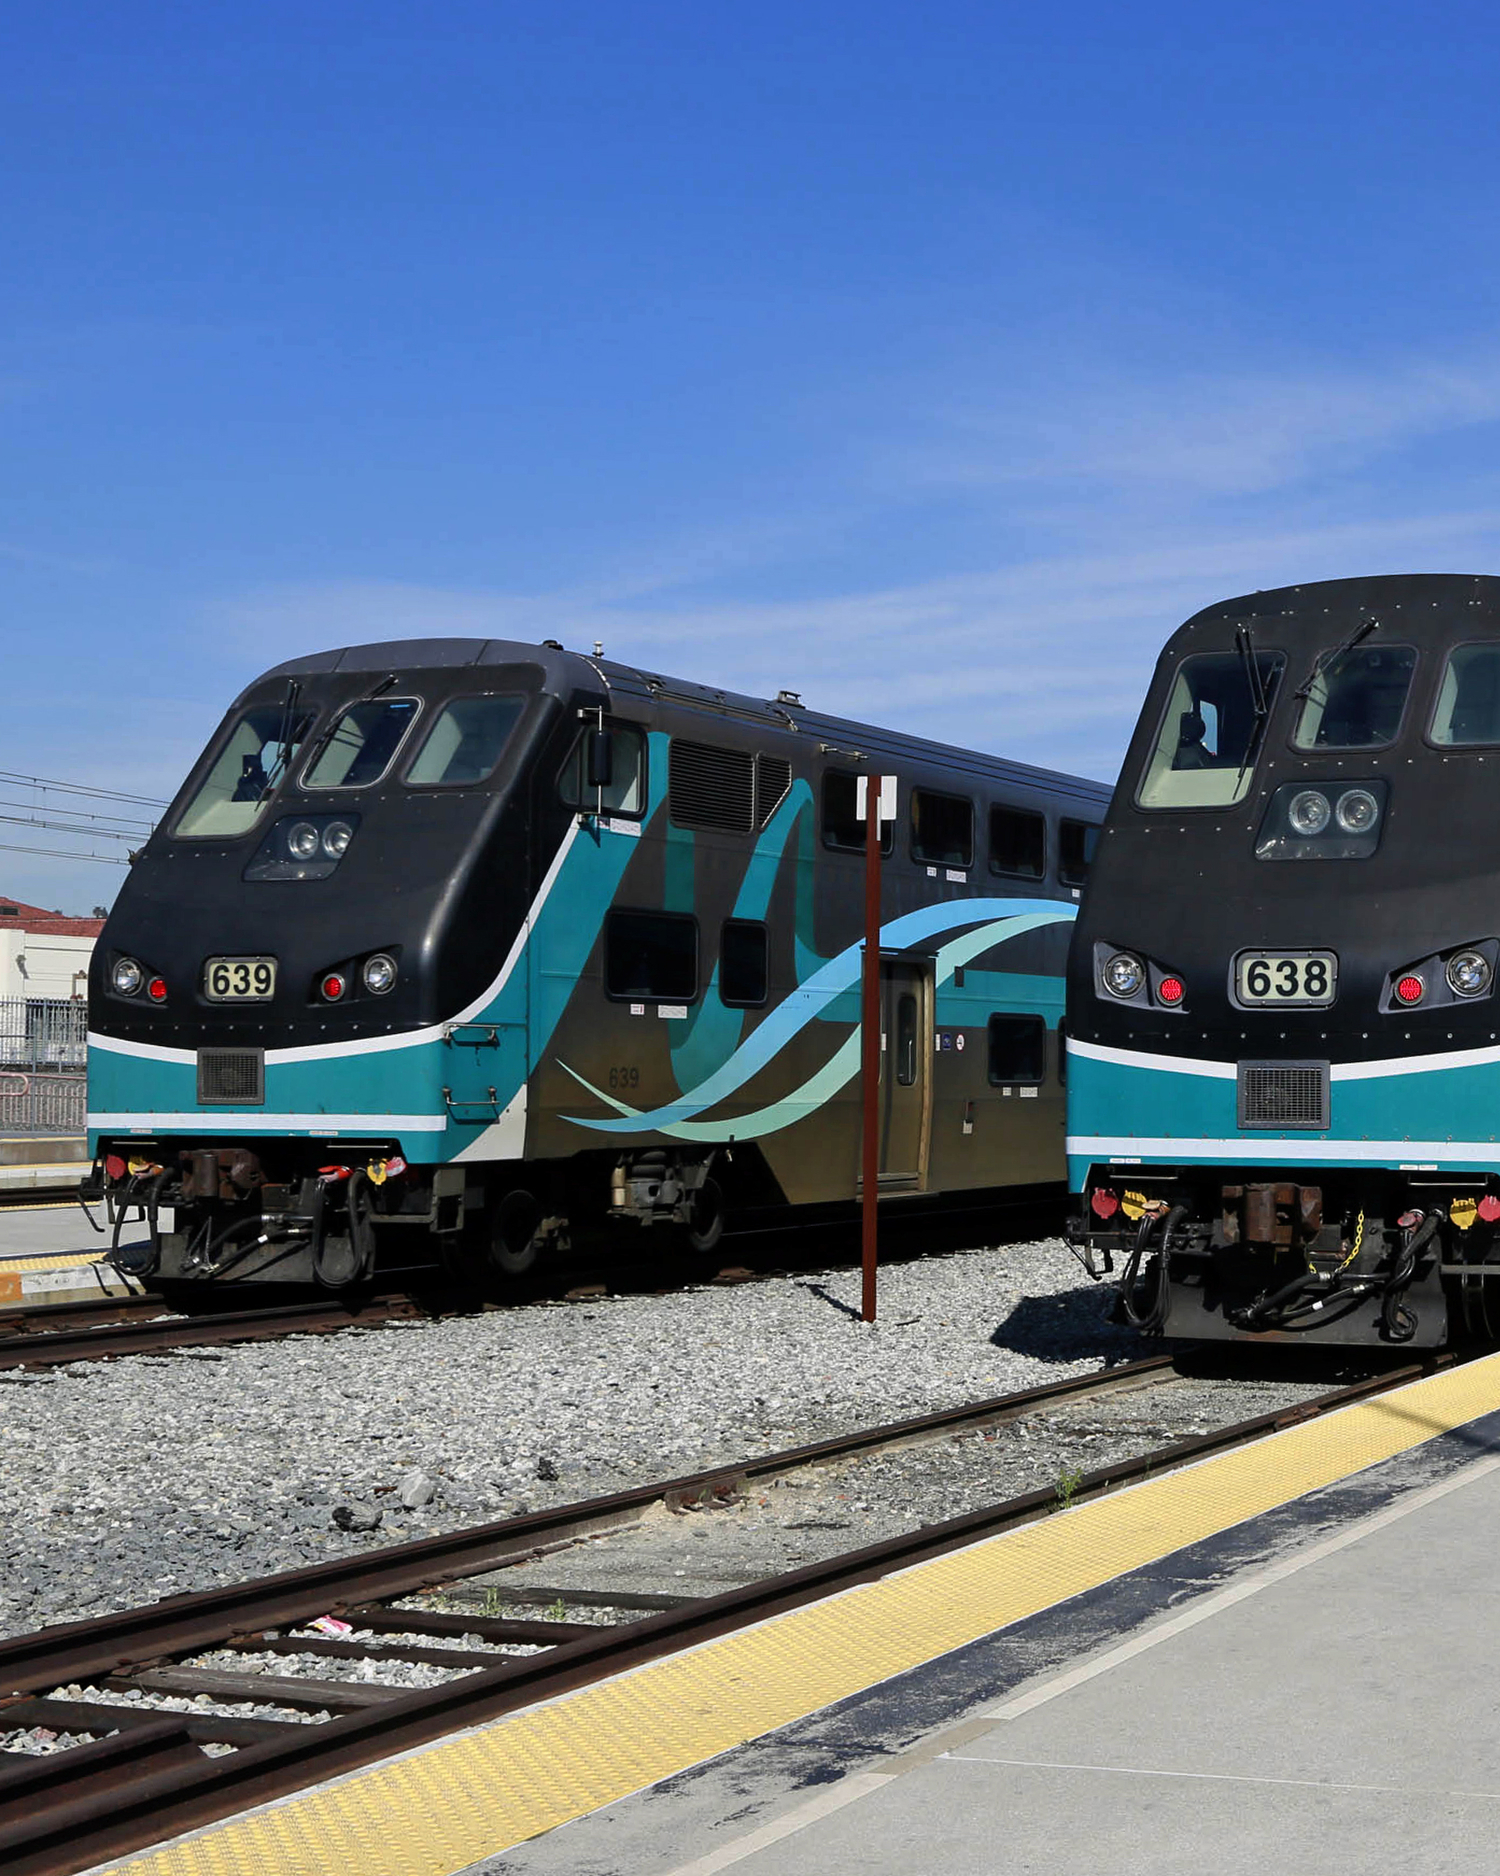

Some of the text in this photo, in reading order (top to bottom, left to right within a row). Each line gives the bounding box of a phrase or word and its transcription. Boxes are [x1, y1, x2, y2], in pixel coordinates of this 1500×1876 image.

[212, 963, 271, 995] 639
[1247, 960, 1328, 997] 638
[609, 1066, 639, 1089] 639
